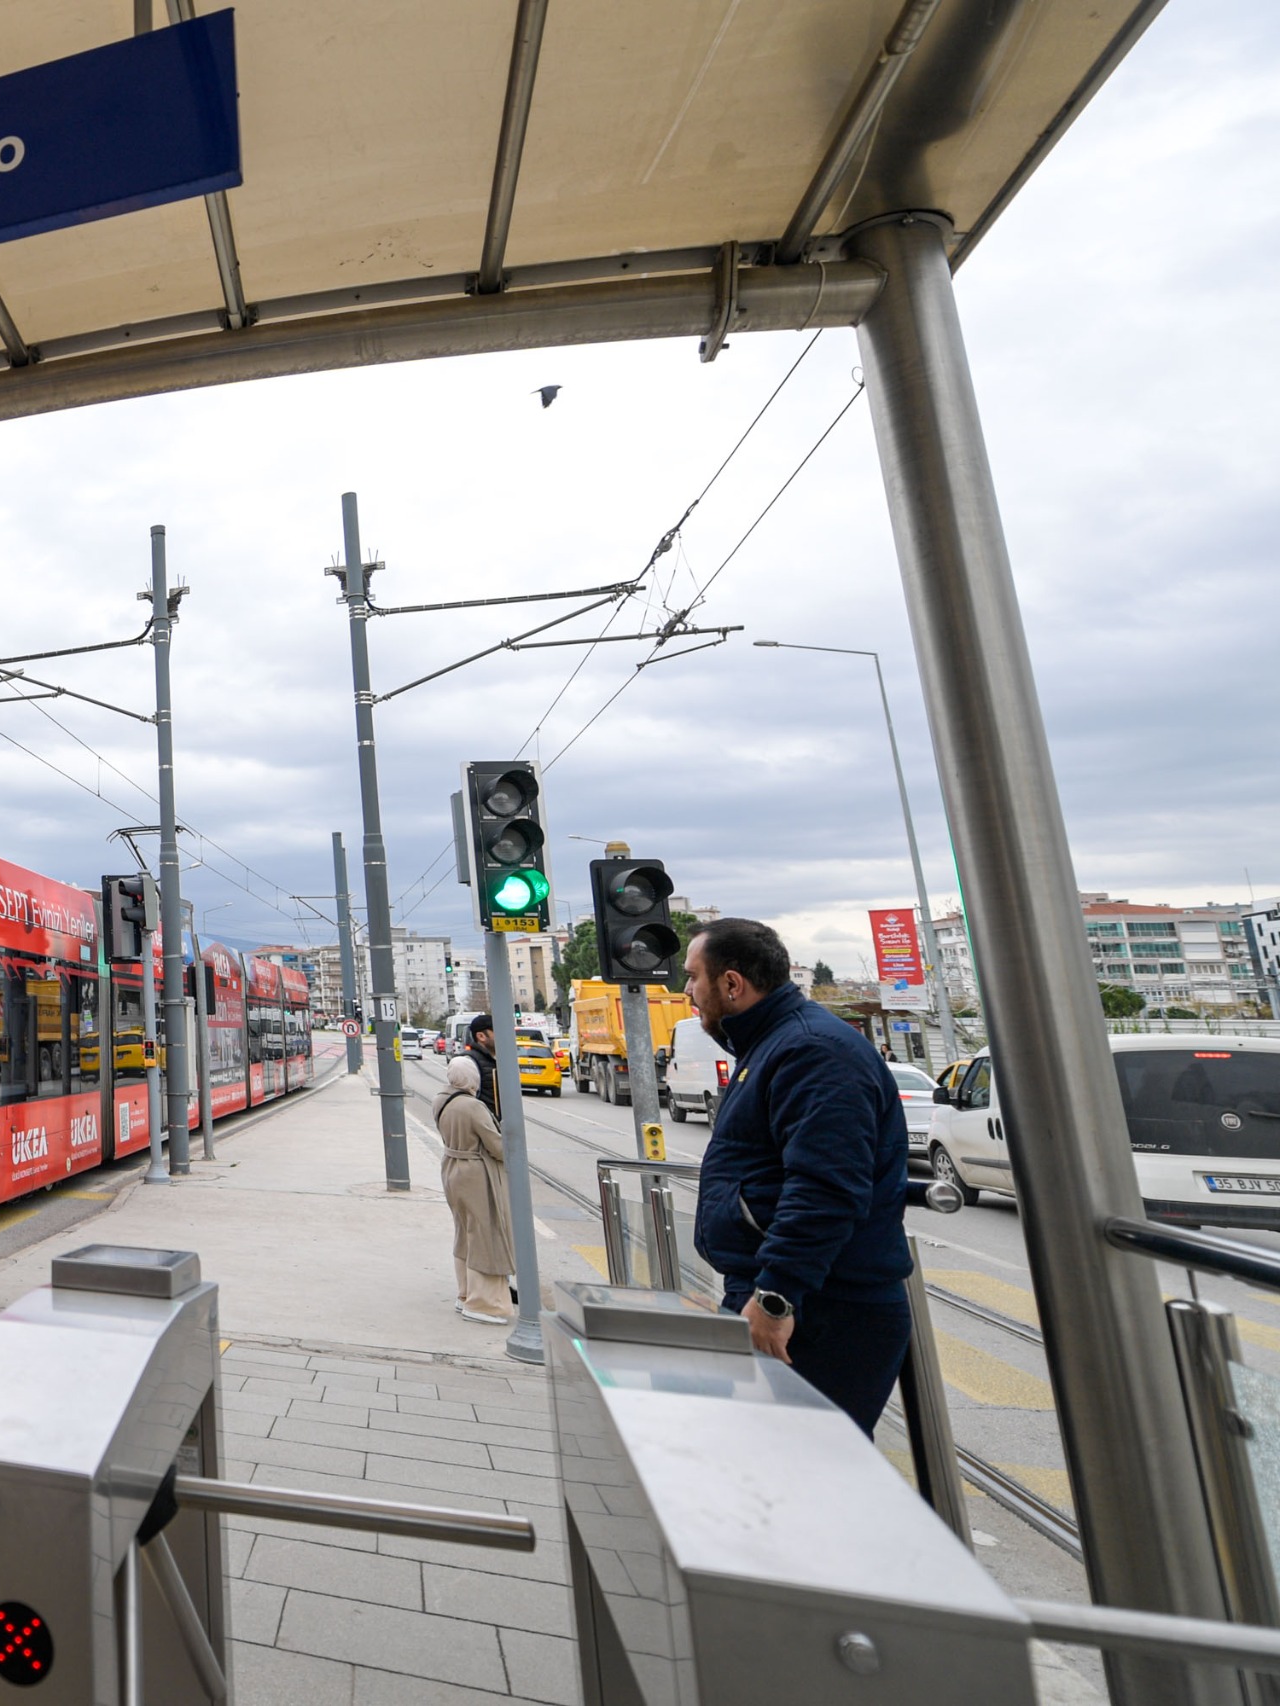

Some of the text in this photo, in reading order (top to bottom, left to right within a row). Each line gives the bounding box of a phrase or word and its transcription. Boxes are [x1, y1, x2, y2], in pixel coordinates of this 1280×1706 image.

[32, 897, 63, 935] Evinizi
[64, 904, 94, 943] Yeniler
[383, 1003, 395, 1017] 15
[1215, 1179, 1233, 1189] 35
[1238, 1179, 1261, 1190] BJV
